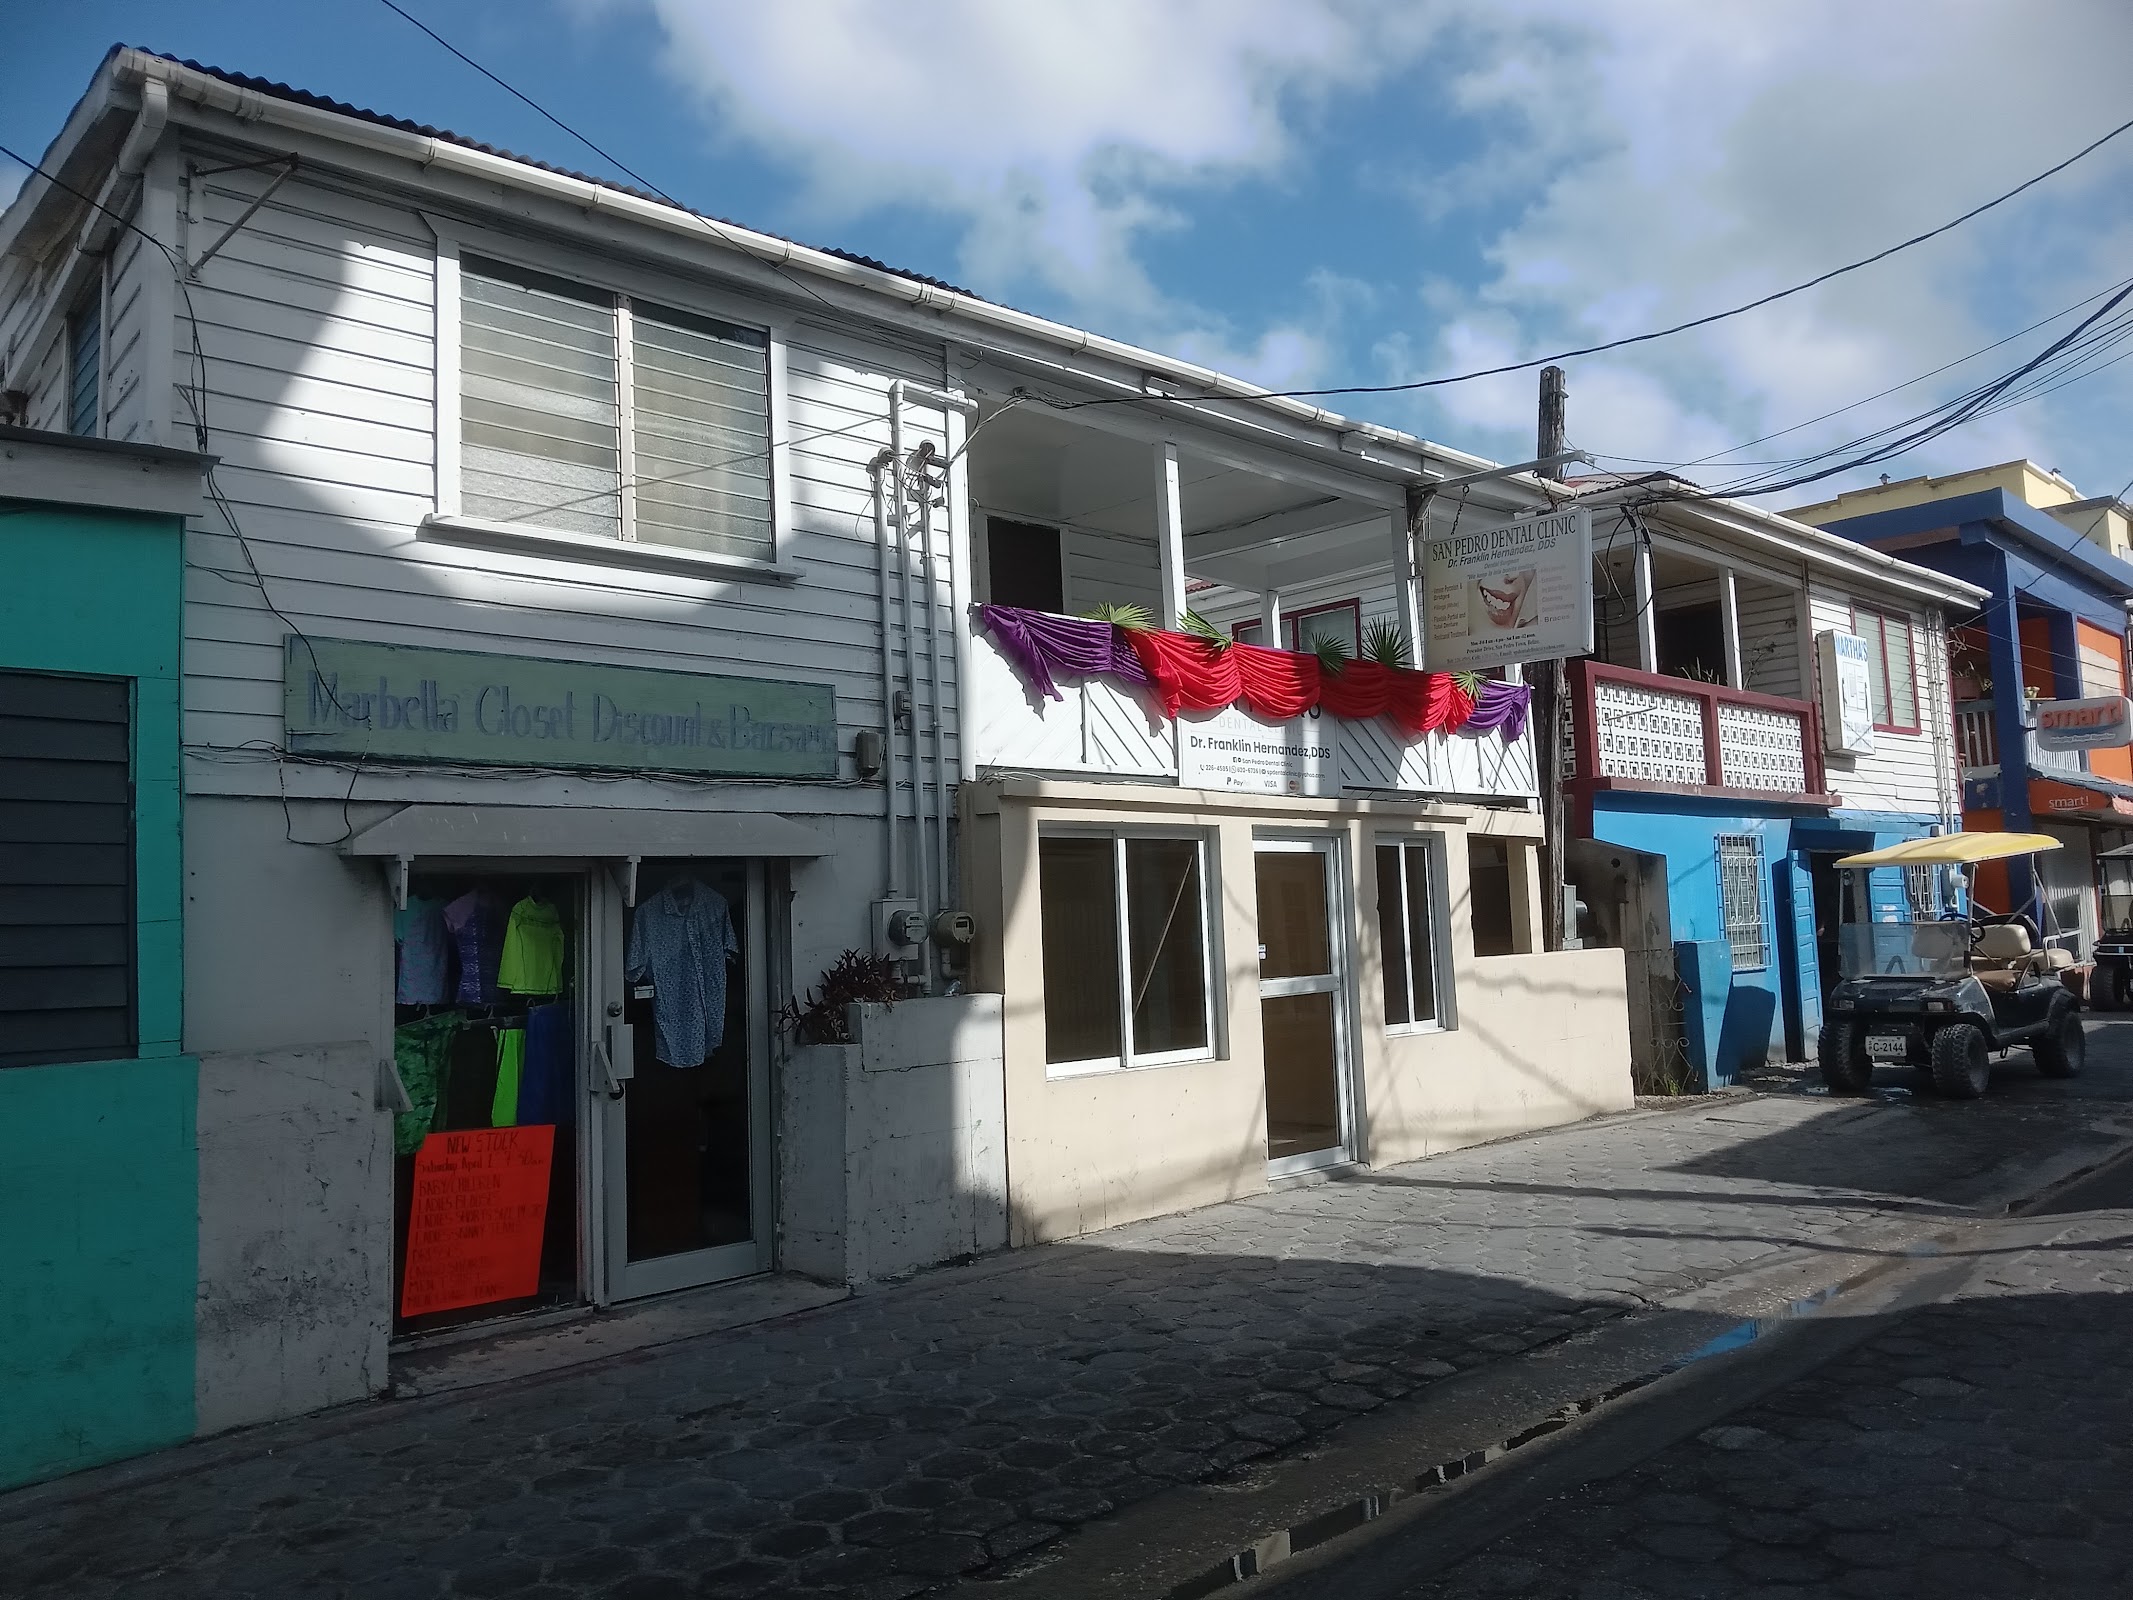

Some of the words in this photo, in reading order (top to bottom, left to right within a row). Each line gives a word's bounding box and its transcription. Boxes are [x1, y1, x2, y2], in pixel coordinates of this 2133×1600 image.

[1432, 541, 1452, 562] SAN
[1455, 533, 1489, 558] PEDRO
[1491, 523, 1535, 550] DENTAL
[1537, 515, 1576, 539] CLINIC
[1447, 558, 1458, 569] Dr.
[1459, 551, 1490, 566] Franklin
[1538, 537, 1557, 550] DDS
[306, 669, 460, 733] Marbella
[475, 685, 576, 741] Closet
[592, 693, 702, 747] Discount
[707, 718, 726, 749] &
[2041, 700, 2124, 729] smart!
[1219, 716, 1262, 732] DENTAL
[1190, 736, 1206, 749] Dr.
[1208, 737, 1251, 753] Franklin
[1264, 780, 1278, 788] VISA
[2048, 795, 2090, 807] smart!
[1873, 1042, 1903, 1052] C-2144
[447, 1135, 471, 1154] NEW
[476, 1131, 519, 1153] STOCK
